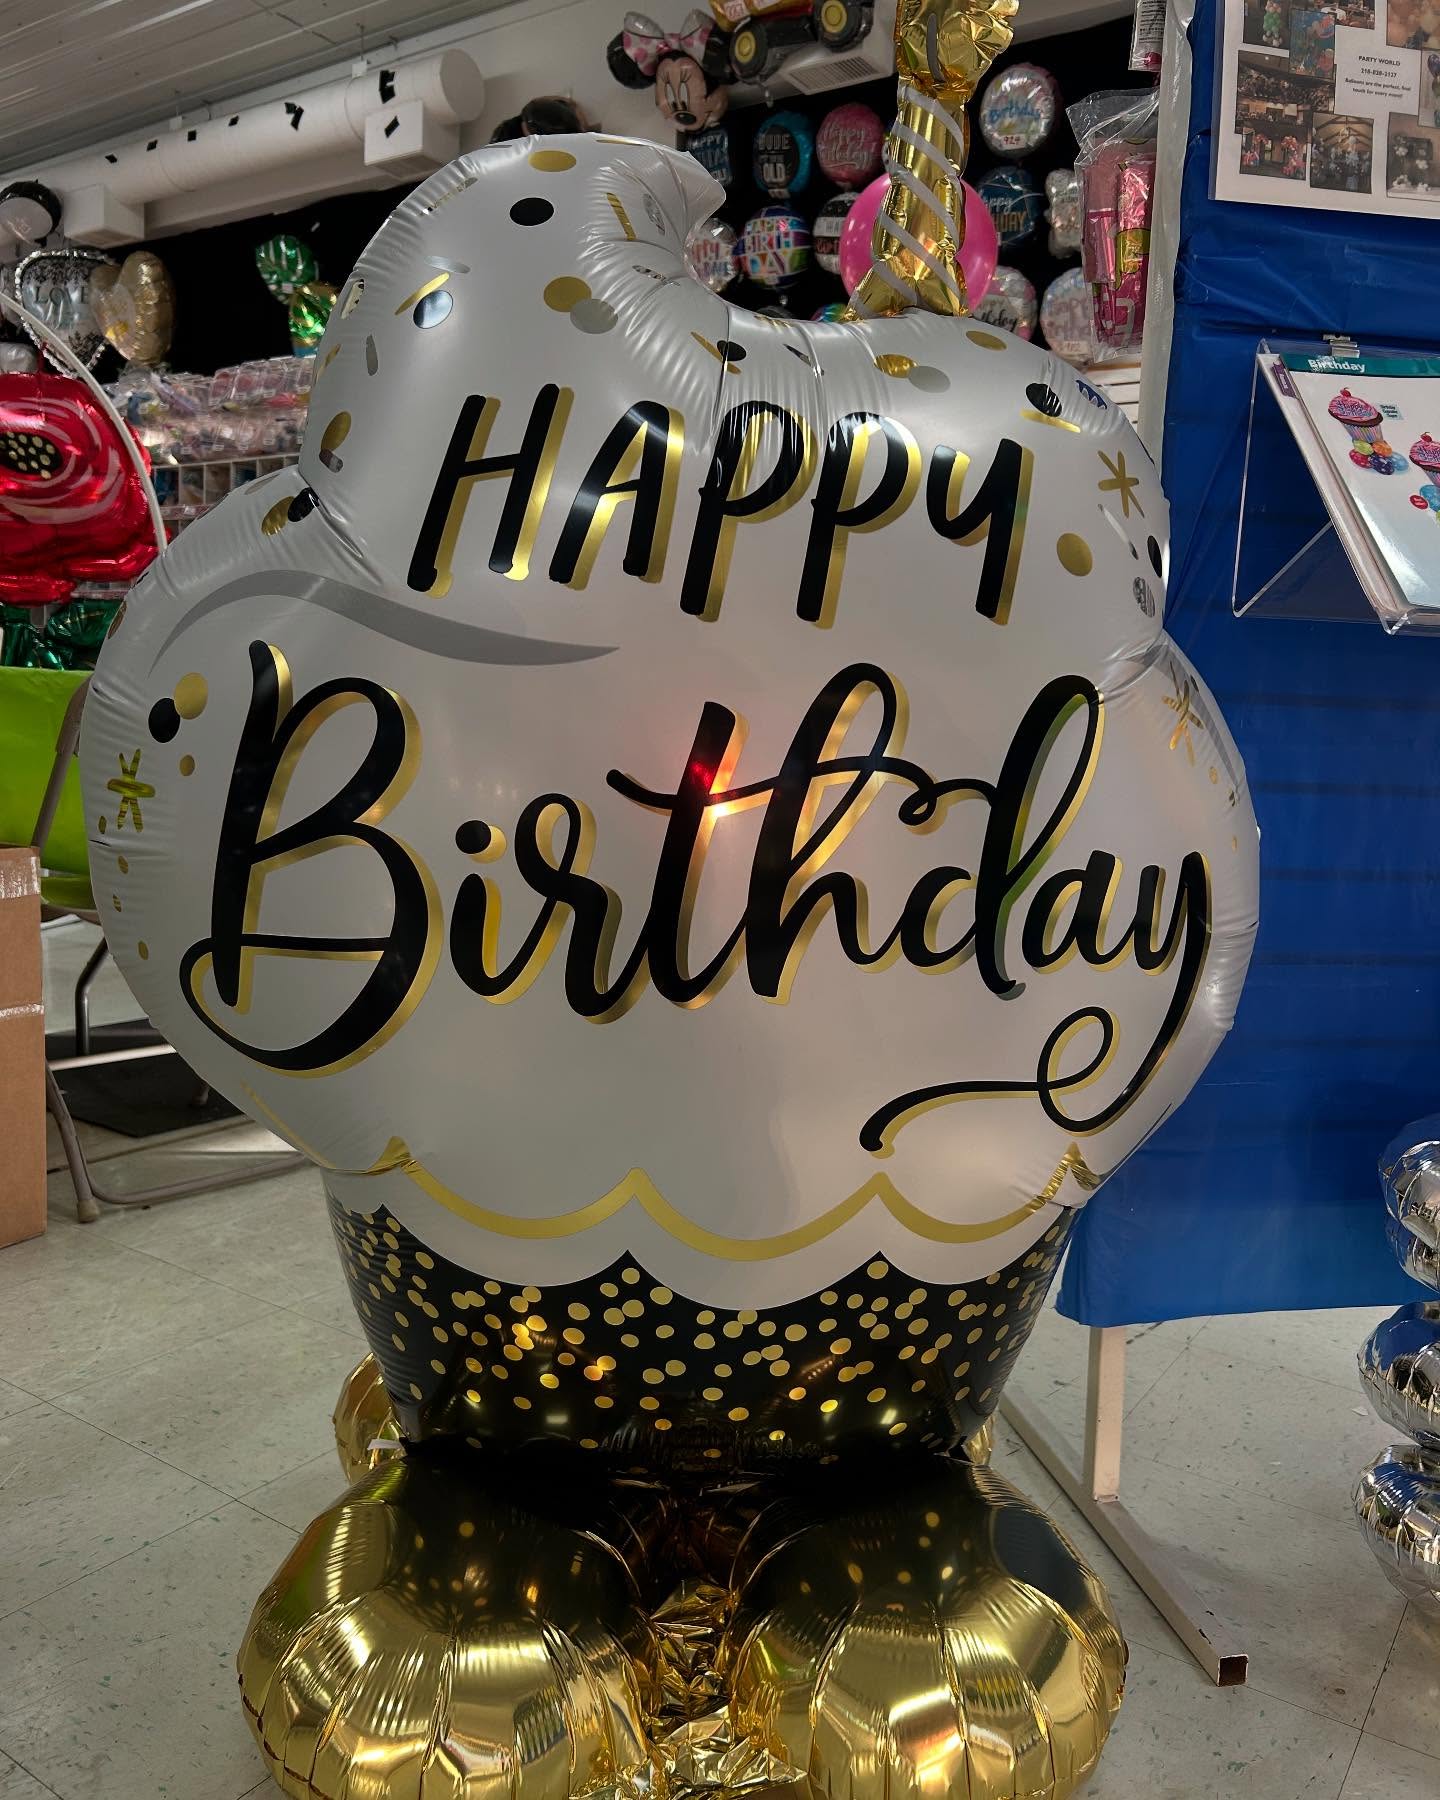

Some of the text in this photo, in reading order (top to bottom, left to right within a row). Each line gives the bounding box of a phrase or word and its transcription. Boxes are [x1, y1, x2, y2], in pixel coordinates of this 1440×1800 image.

[1358, 55, 1401, 67] PARTY WORLD
[762, 163, 786, 182] OLD
[750, 249, 793, 276] DAY
[1308, 357, 1366, 373] Birthday
[407, 383, 1034, 629] HAPPY
[180, 640, 1212, 1158] Birthday
